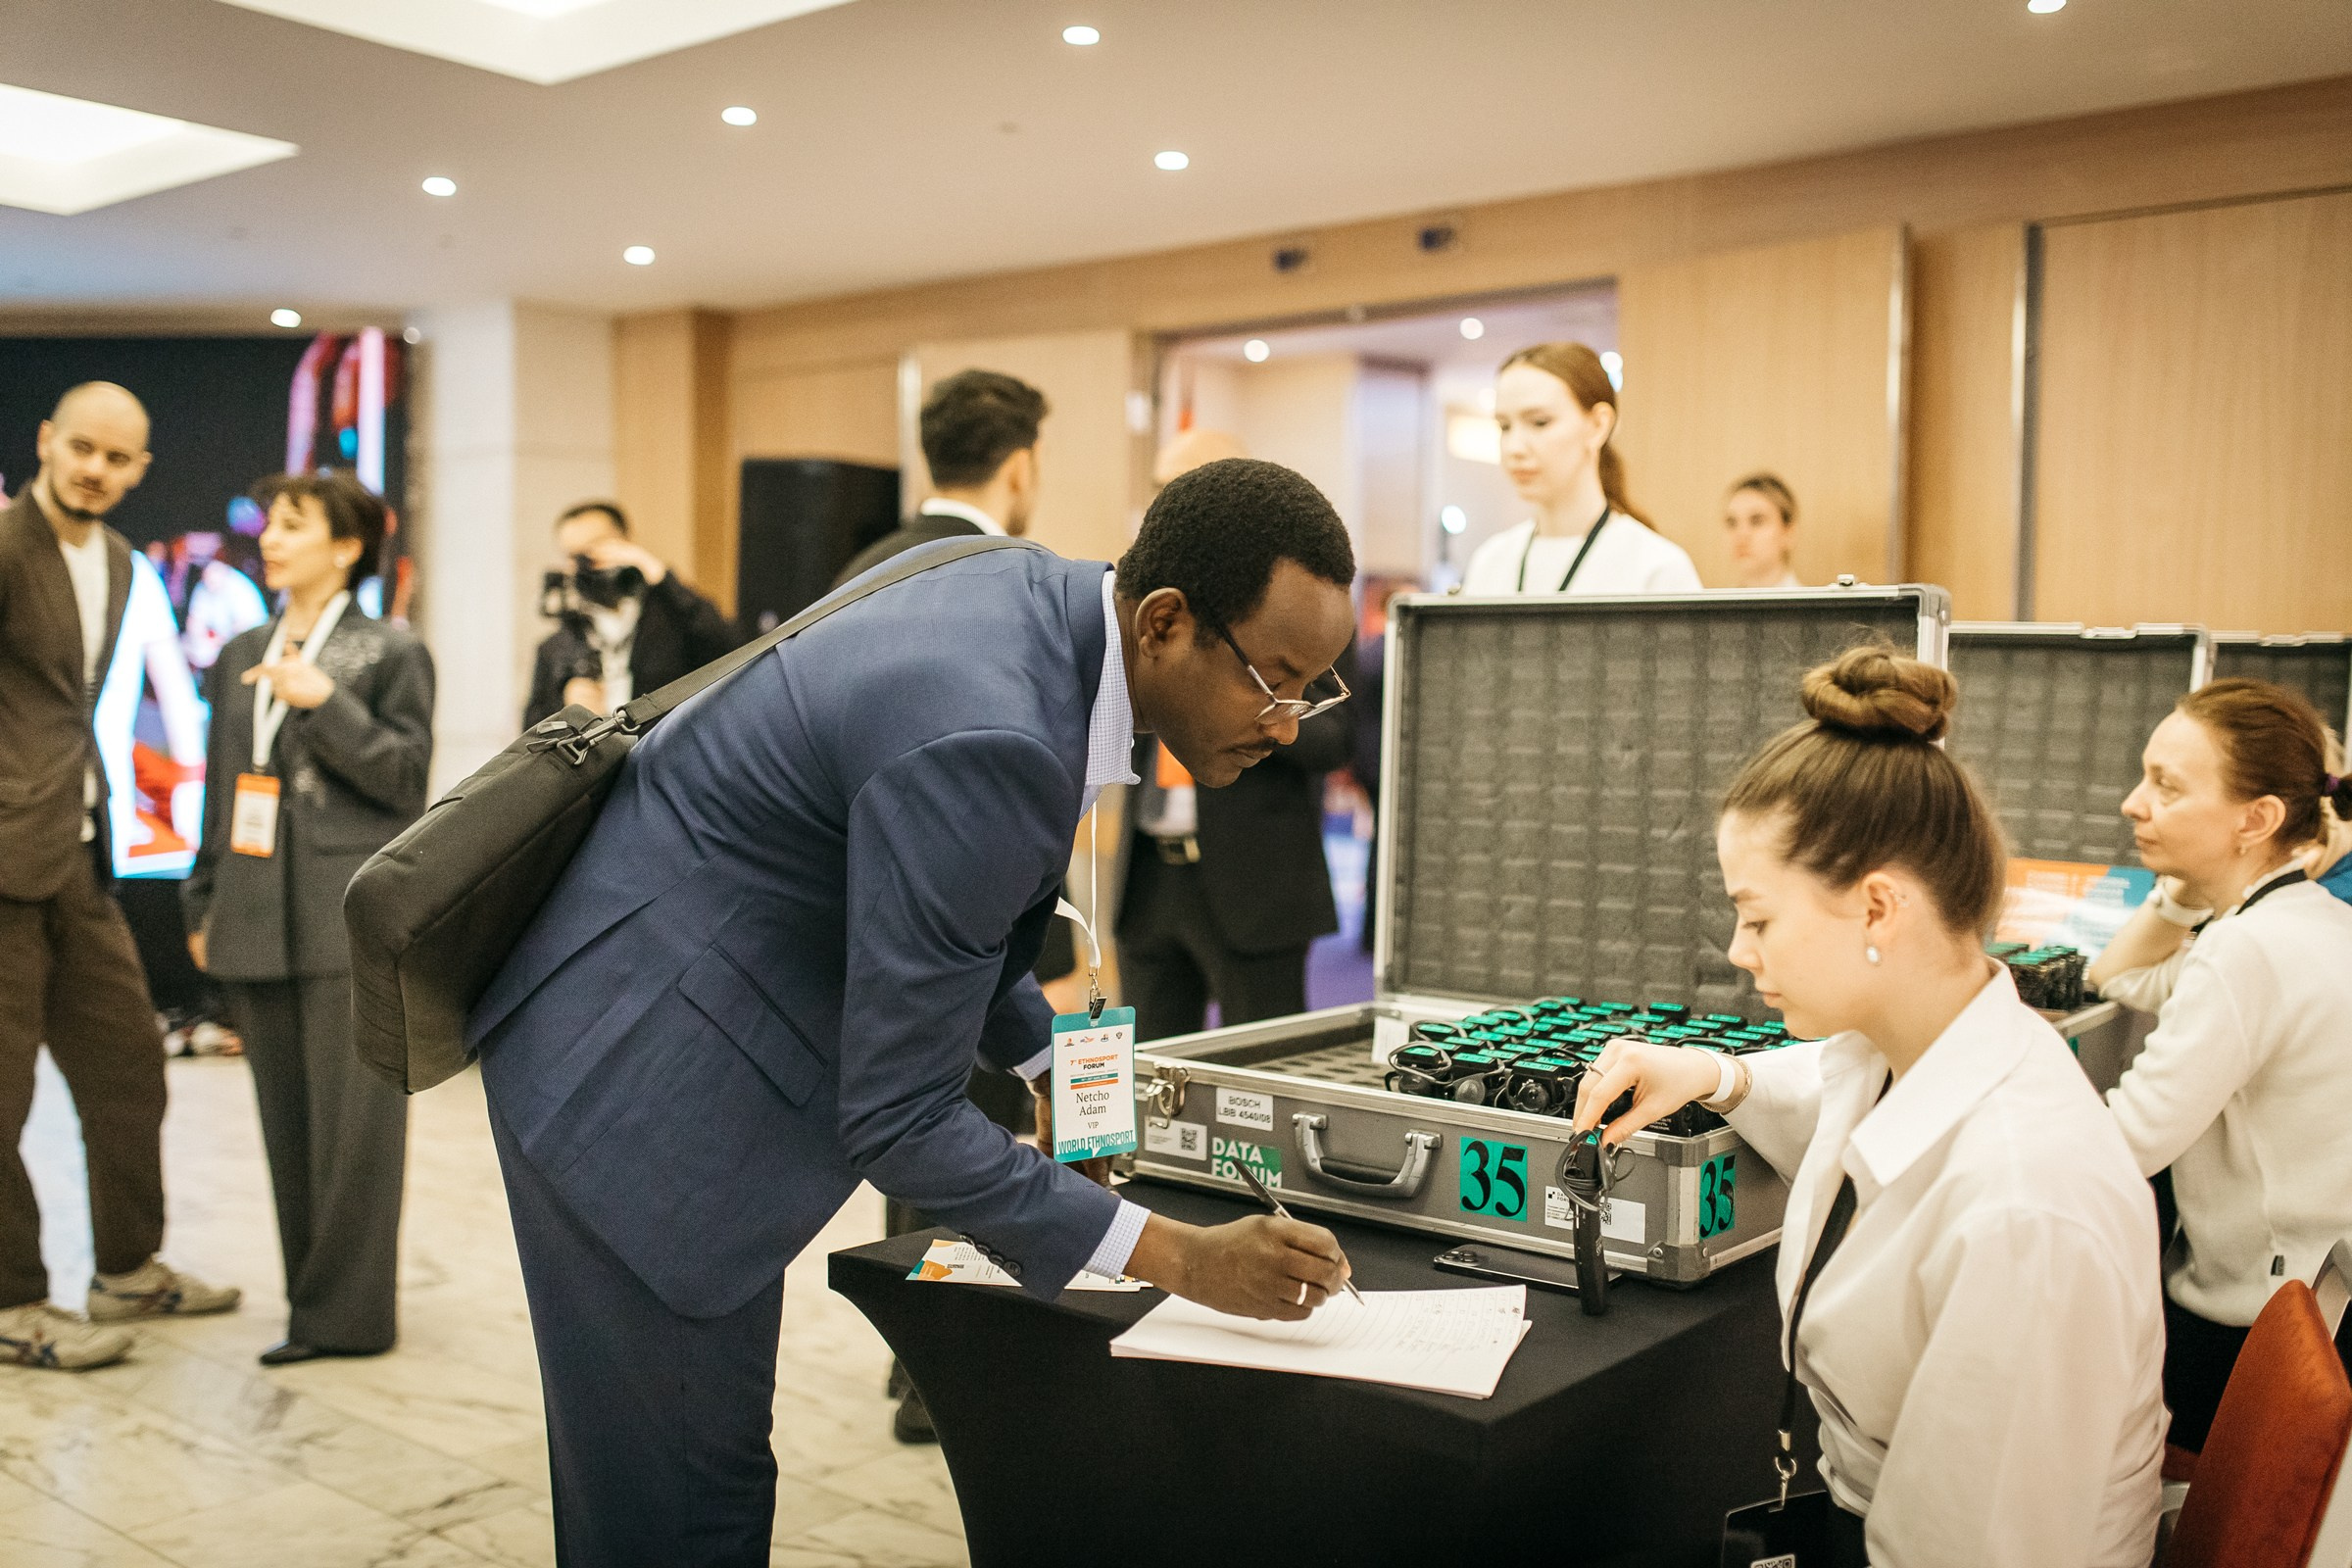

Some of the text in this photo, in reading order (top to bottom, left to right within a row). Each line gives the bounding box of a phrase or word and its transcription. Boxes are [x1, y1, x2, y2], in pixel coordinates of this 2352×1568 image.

[1078, 1054, 1118, 1065] ETHNOSPORT
[1076, 1090, 1110, 1103] Netcho
[1229, 1096, 1261, 1107] BOSCH
[1079, 1104, 1106, 1116] Adam
[1218, 1106, 1237, 1117] LBB
[1058, 1138, 1086, 1153] WORLD
[1088, 1130, 1133, 1150] ETHNOSPORT
[1212, 1137, 1264, 1164] DATA
[1461, 1140, 1526, 1217] 35
[1700, 1154, 1736, 1239] 35
